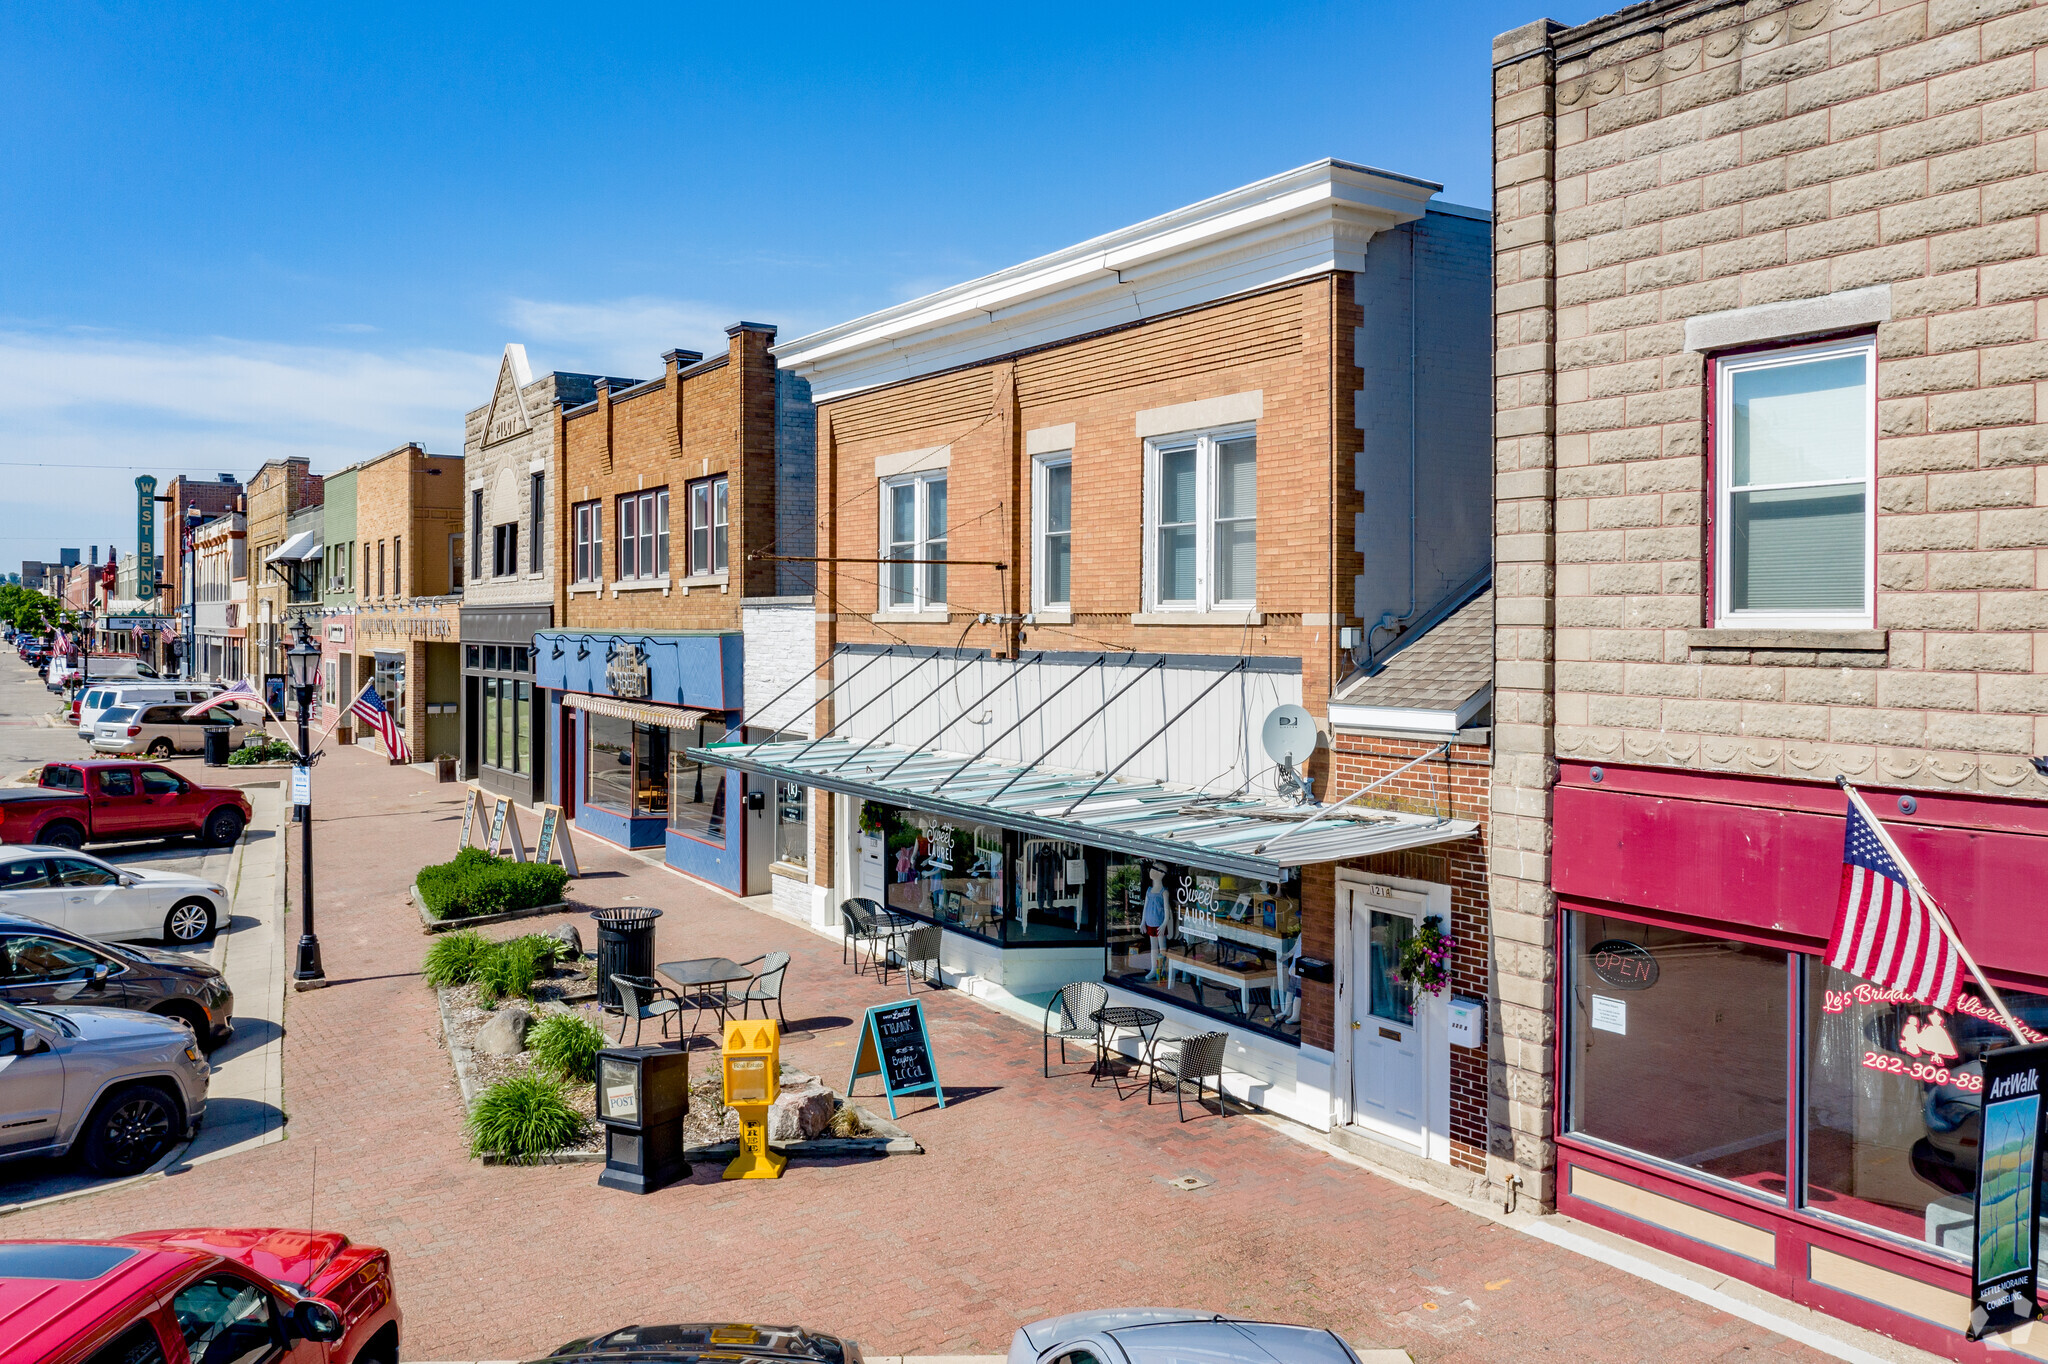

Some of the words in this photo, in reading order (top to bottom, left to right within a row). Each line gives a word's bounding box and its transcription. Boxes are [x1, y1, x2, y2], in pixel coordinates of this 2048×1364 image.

[140, 482, 153, 536] WEST
[140, 542, 152, 596] BEND
[926, 819, 955, 848] Sweet
[927, 843, 953, 862] LAUREL
[1177, 875, 1219, 911] Sweet
[1178, 905, 1218, 929] LAUREL
[1595, 950, 1651, 981] OPEN
[1822, 990, 1851, 1013] Le's
[880, 1019, 914, 1035] THANK
[891, 1053, 918, 1069] Buying
[1864, 1051, 1983, 1091] 262-306-88
[1989, 1068, 2040, 1100] ArtWalk
[610, 1096, 635, 1109] POST
[746, 1121, 759, 1153] FREE
[1980, 1284, 2001, 1298] KETTLE
[2001, 1275, 2029, 1290] MORAINE
[1986, 1291, 2023, 1311] COUNSELING
